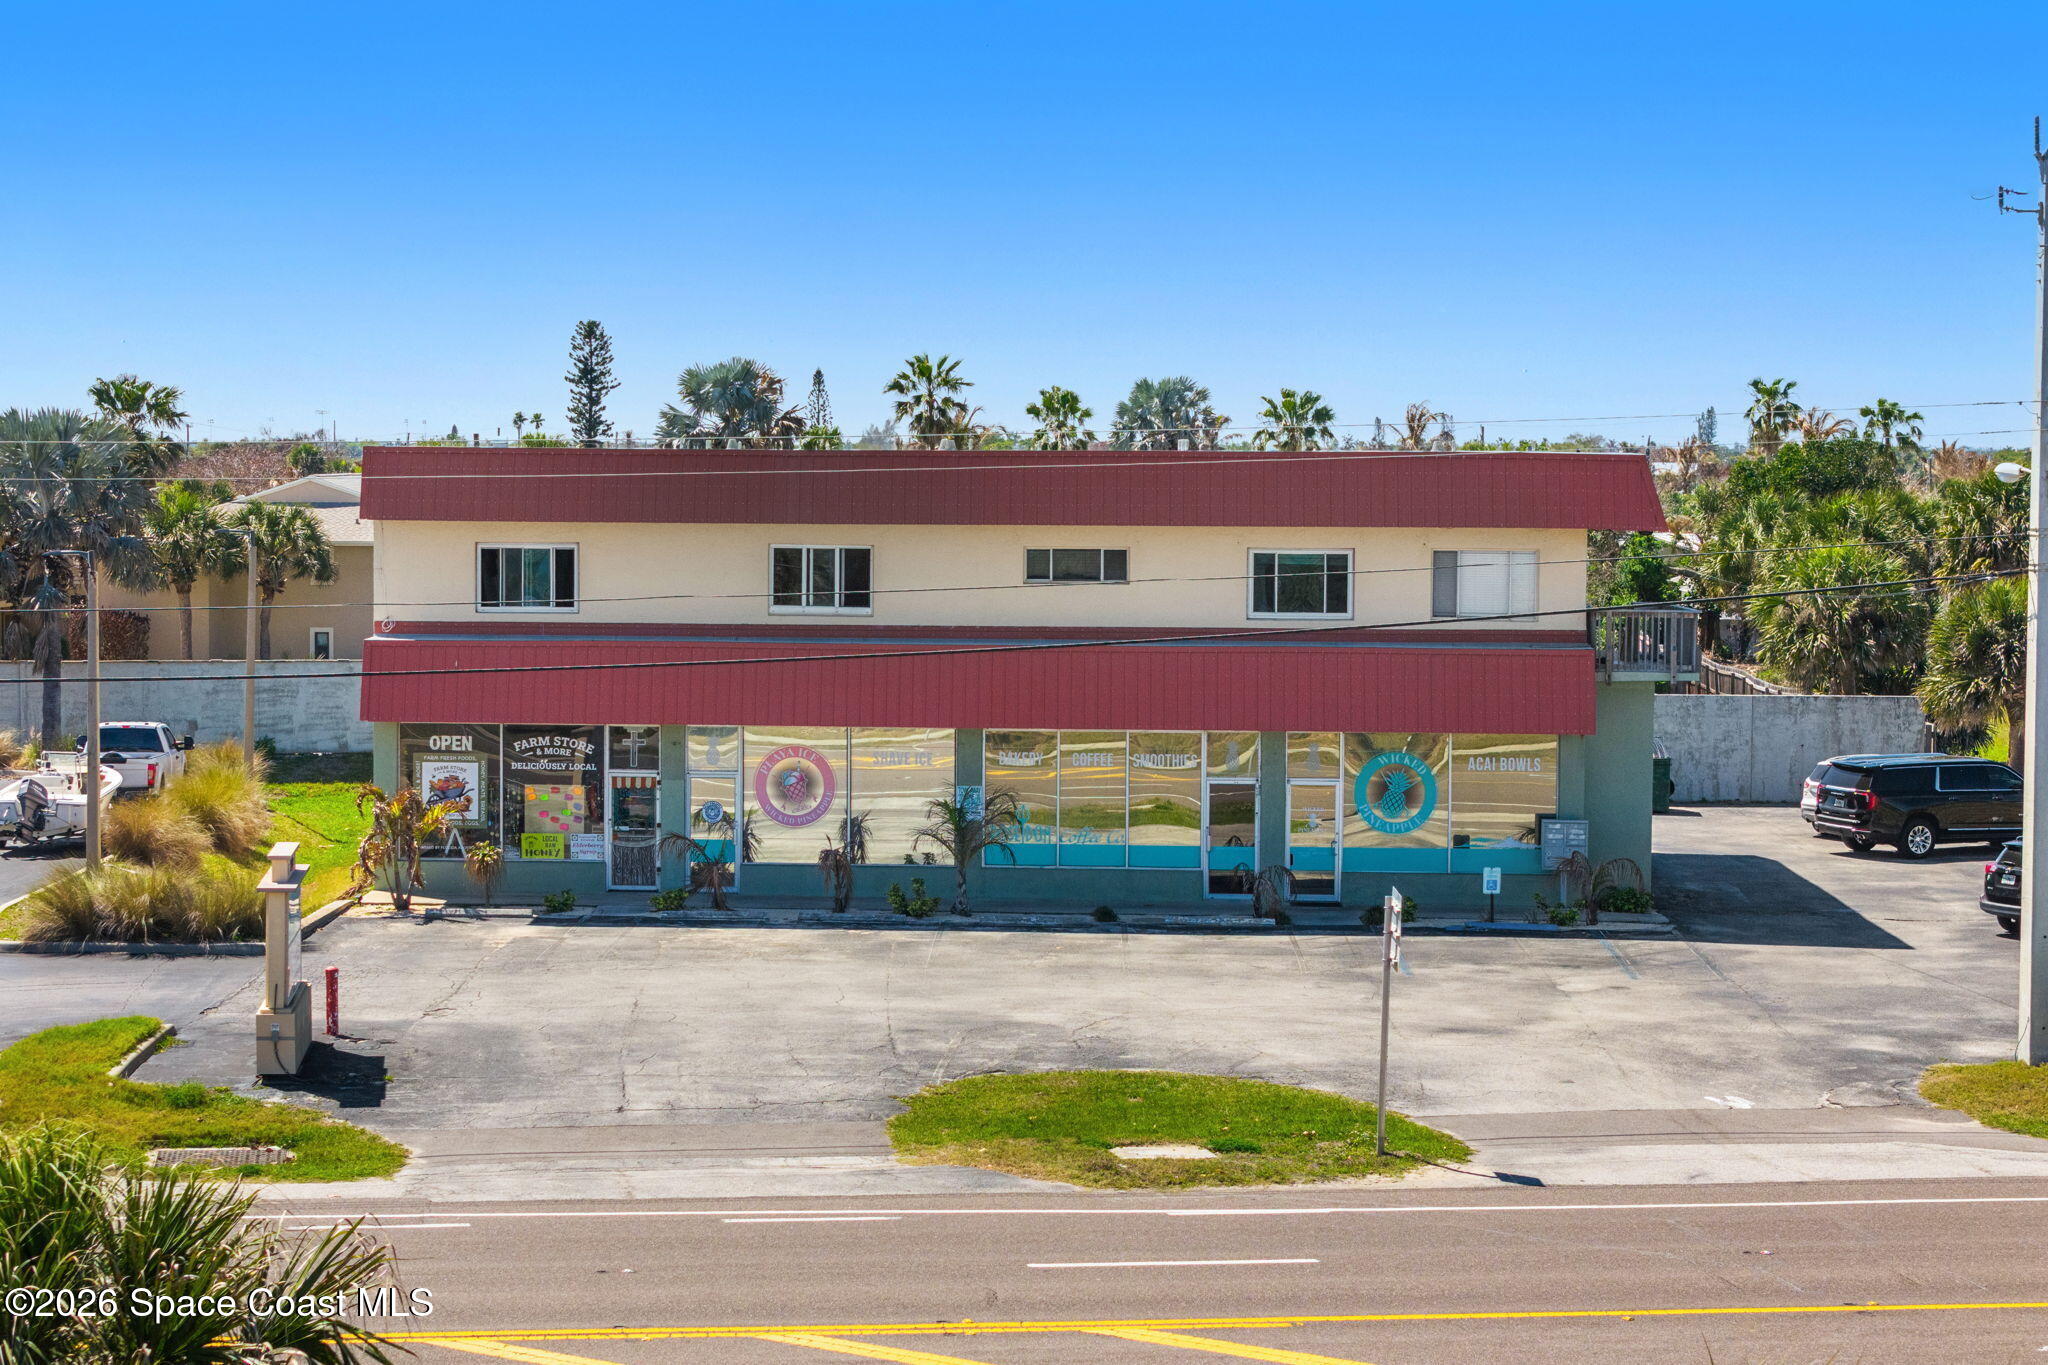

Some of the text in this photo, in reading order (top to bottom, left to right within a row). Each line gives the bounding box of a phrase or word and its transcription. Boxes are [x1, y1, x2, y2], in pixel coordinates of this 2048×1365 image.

[429, 735, 473, 751] OPEN
[513, 735, 595, 755] FARM STORE
[536, 747, 572, 756] & MORE
[798, 748, 820, 763] ICE
[872, 751, 933, 766] SHAVE ICE
[998, 751, 1044, 766] BAKERY
[511, 762, 597, 771] DELICIOUSLY LOCAL
[1072, 752, 1114, 767] COFFEE
[1132, 753, 1198, 768] SMOOTHIES
[1377, 754, 1427, 775] WICKED
[1467, 756, 1541, 772] ACAI BOWLS
[1359, 803, 1422, 833] PINEAPPLE
[525, 848, 561, 857] HONEY
